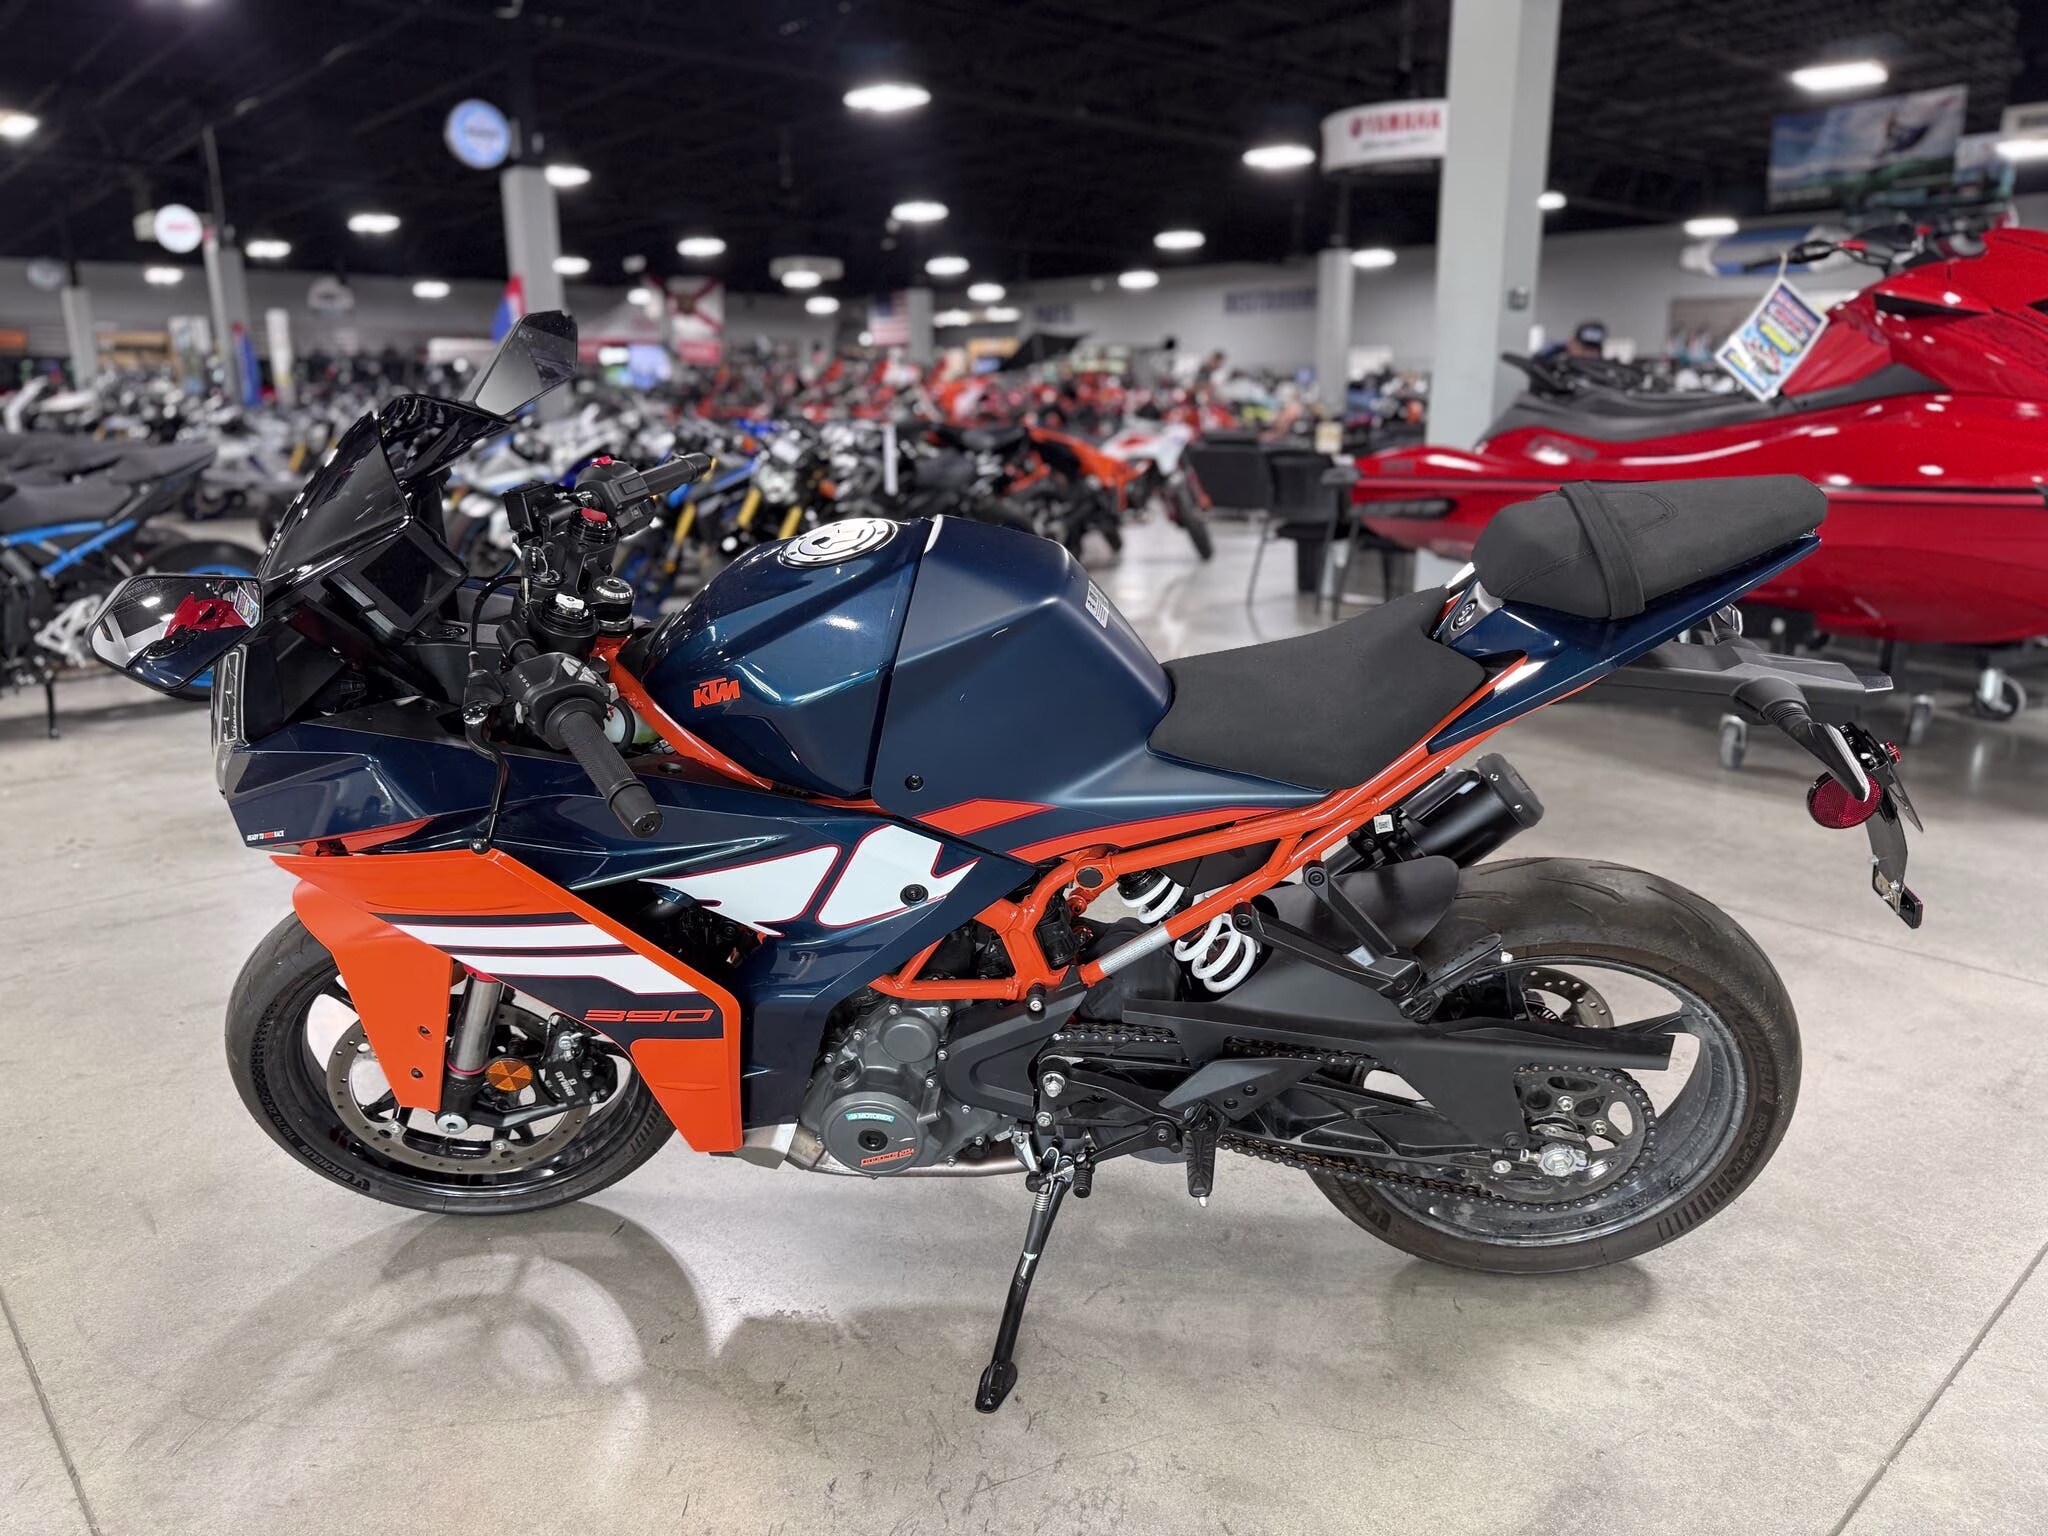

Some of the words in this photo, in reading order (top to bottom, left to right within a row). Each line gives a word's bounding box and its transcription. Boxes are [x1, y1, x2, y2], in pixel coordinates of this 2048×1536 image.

[693, 677, 741, 708] KTM
[584, 1009, 714, 1022] 390
[298, 1143, 353, 1181] MICHELIN
